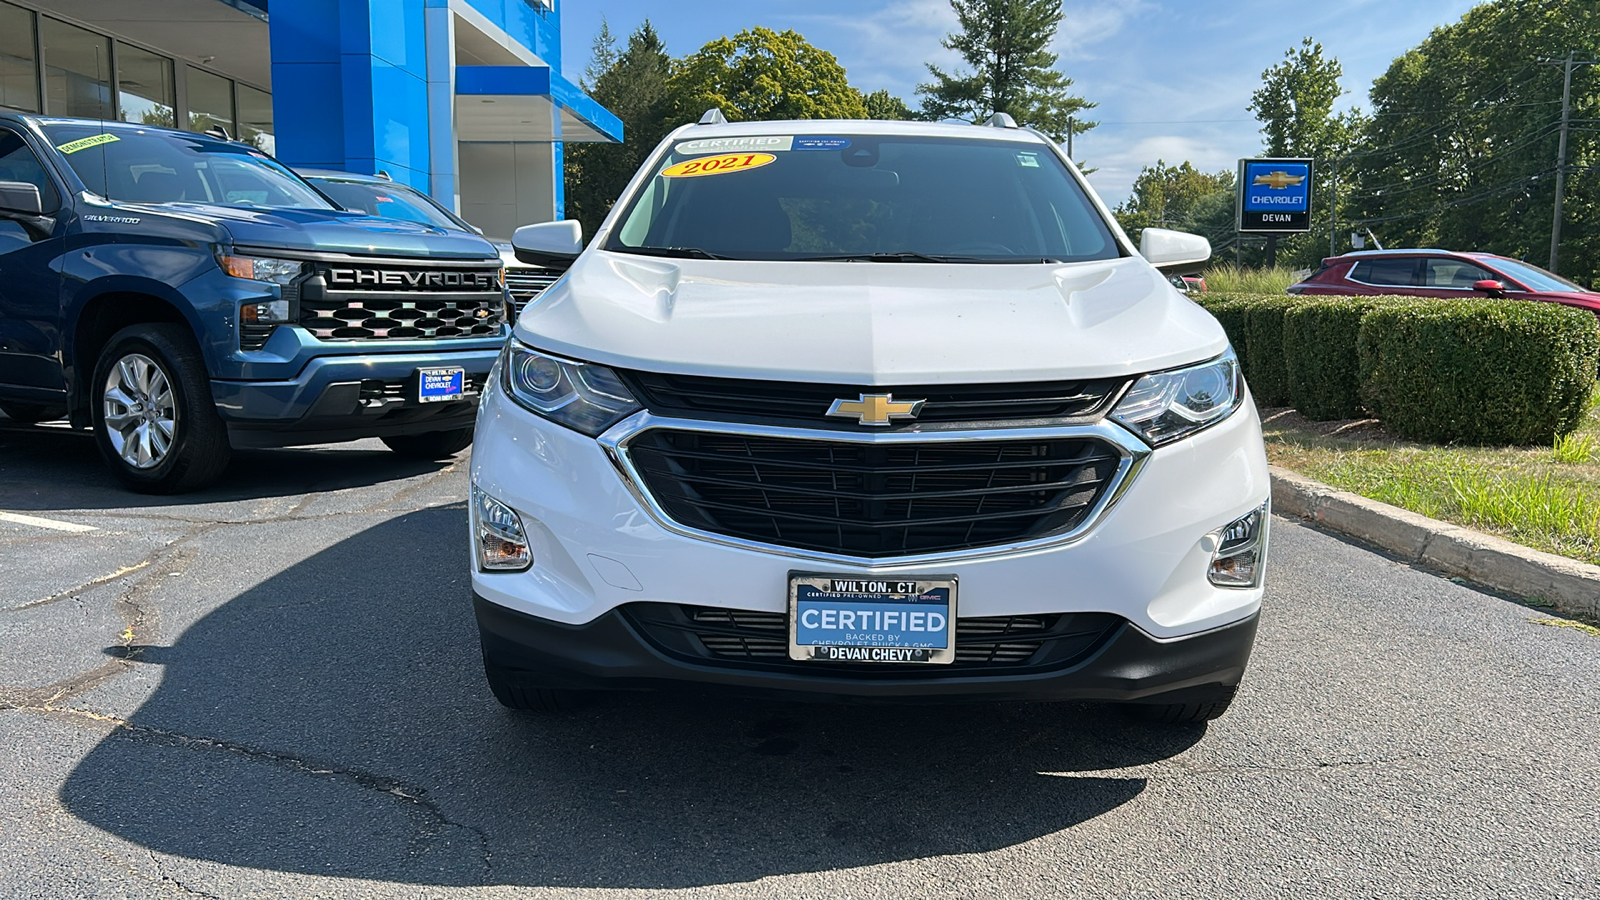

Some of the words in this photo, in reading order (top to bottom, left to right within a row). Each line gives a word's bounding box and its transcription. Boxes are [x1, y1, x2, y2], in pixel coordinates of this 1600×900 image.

[687, 137, 781, 149] CERTIFIED
[681, 154, 756, 176] 2021
[1251, 195, 1303, 204] CHEVROLET
[84, 214, 141, 224] SILVERADO
[1262, 213, 1291, 222] DEVAN
[331, 268, 497, 287] CHEVROLET
[835, 581, 892, 593] WILTON,
[897, 582, 914, 593] CT
[801, 609, 946, 632] CERTIFIED
[845, 633, 885, 641] BACKED
[829, 647, 869, 660] DEVAN
[871, 649, 913, 661] CHEVY
